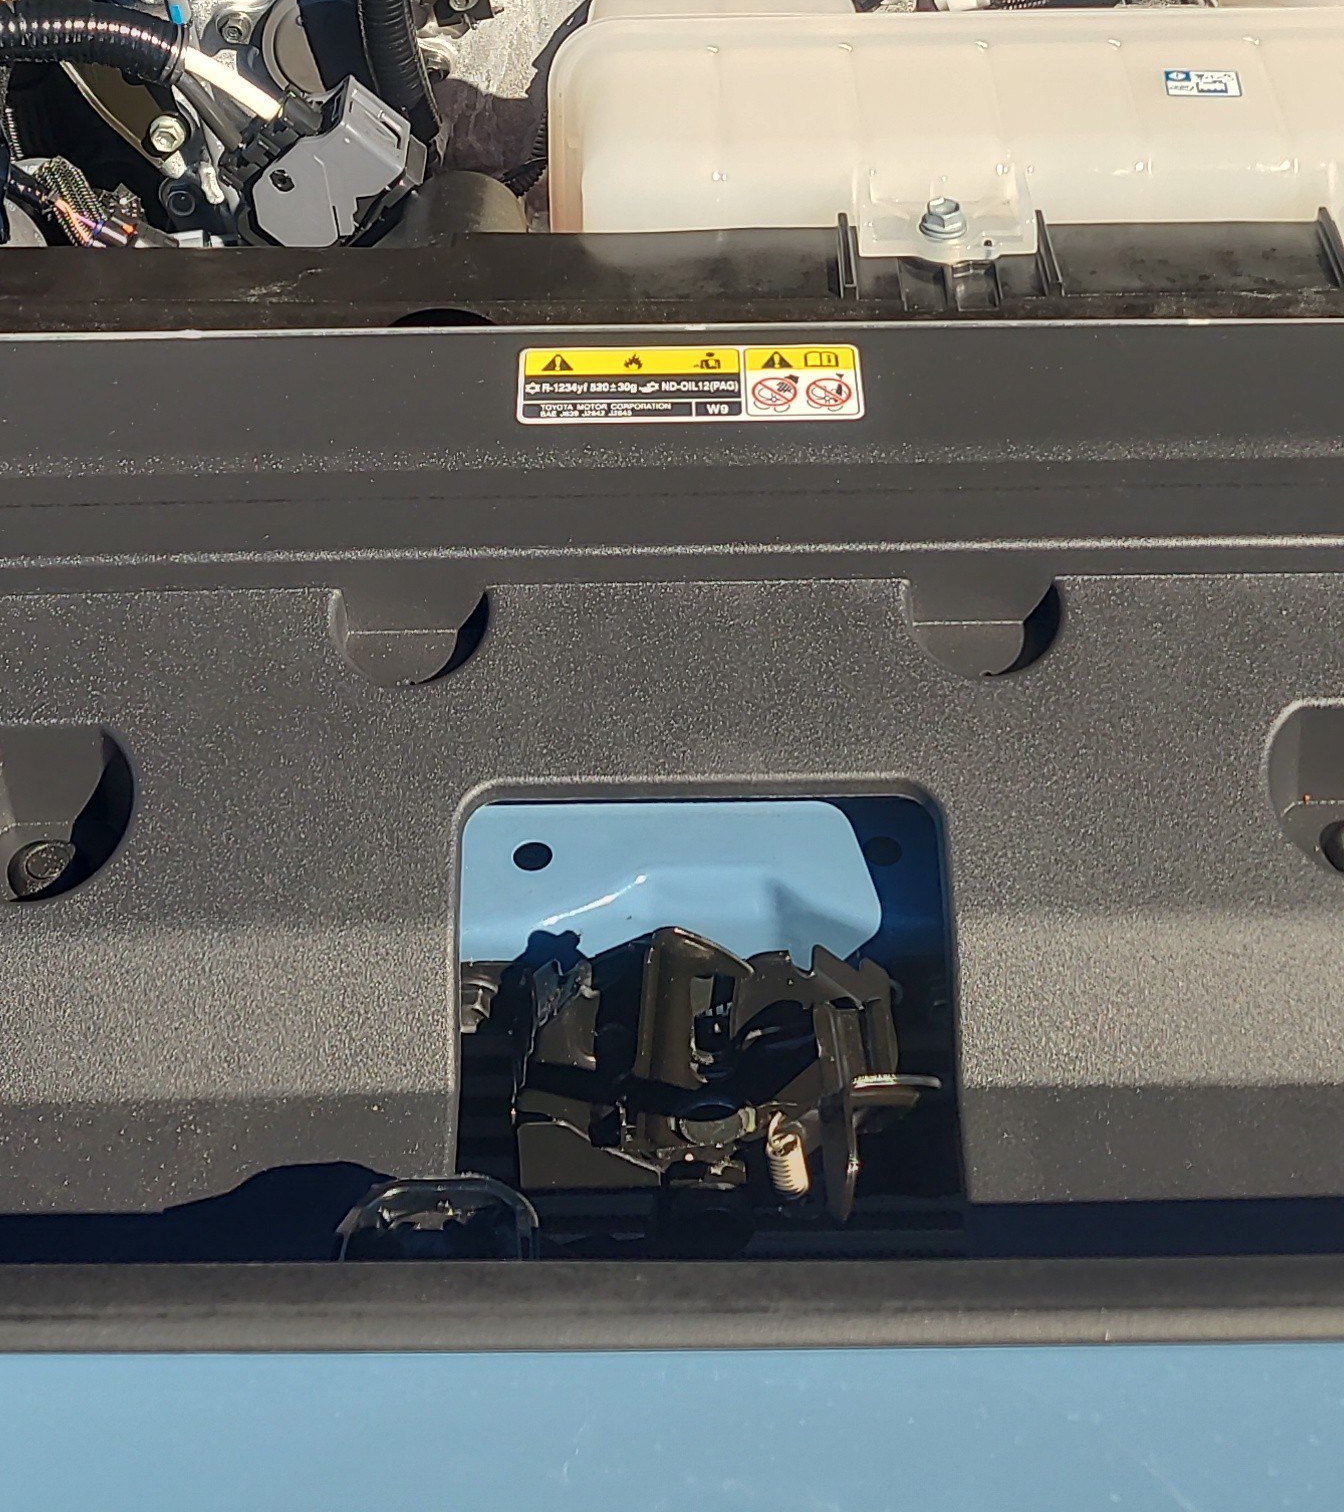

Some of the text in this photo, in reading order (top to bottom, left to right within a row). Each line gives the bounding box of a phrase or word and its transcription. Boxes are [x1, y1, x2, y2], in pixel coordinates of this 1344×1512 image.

[661, 380, 739, 393] ND-OIL12(PAG)
[576, 403, 607, 411] MOTOR
[706, 403, 729, 414] W9
